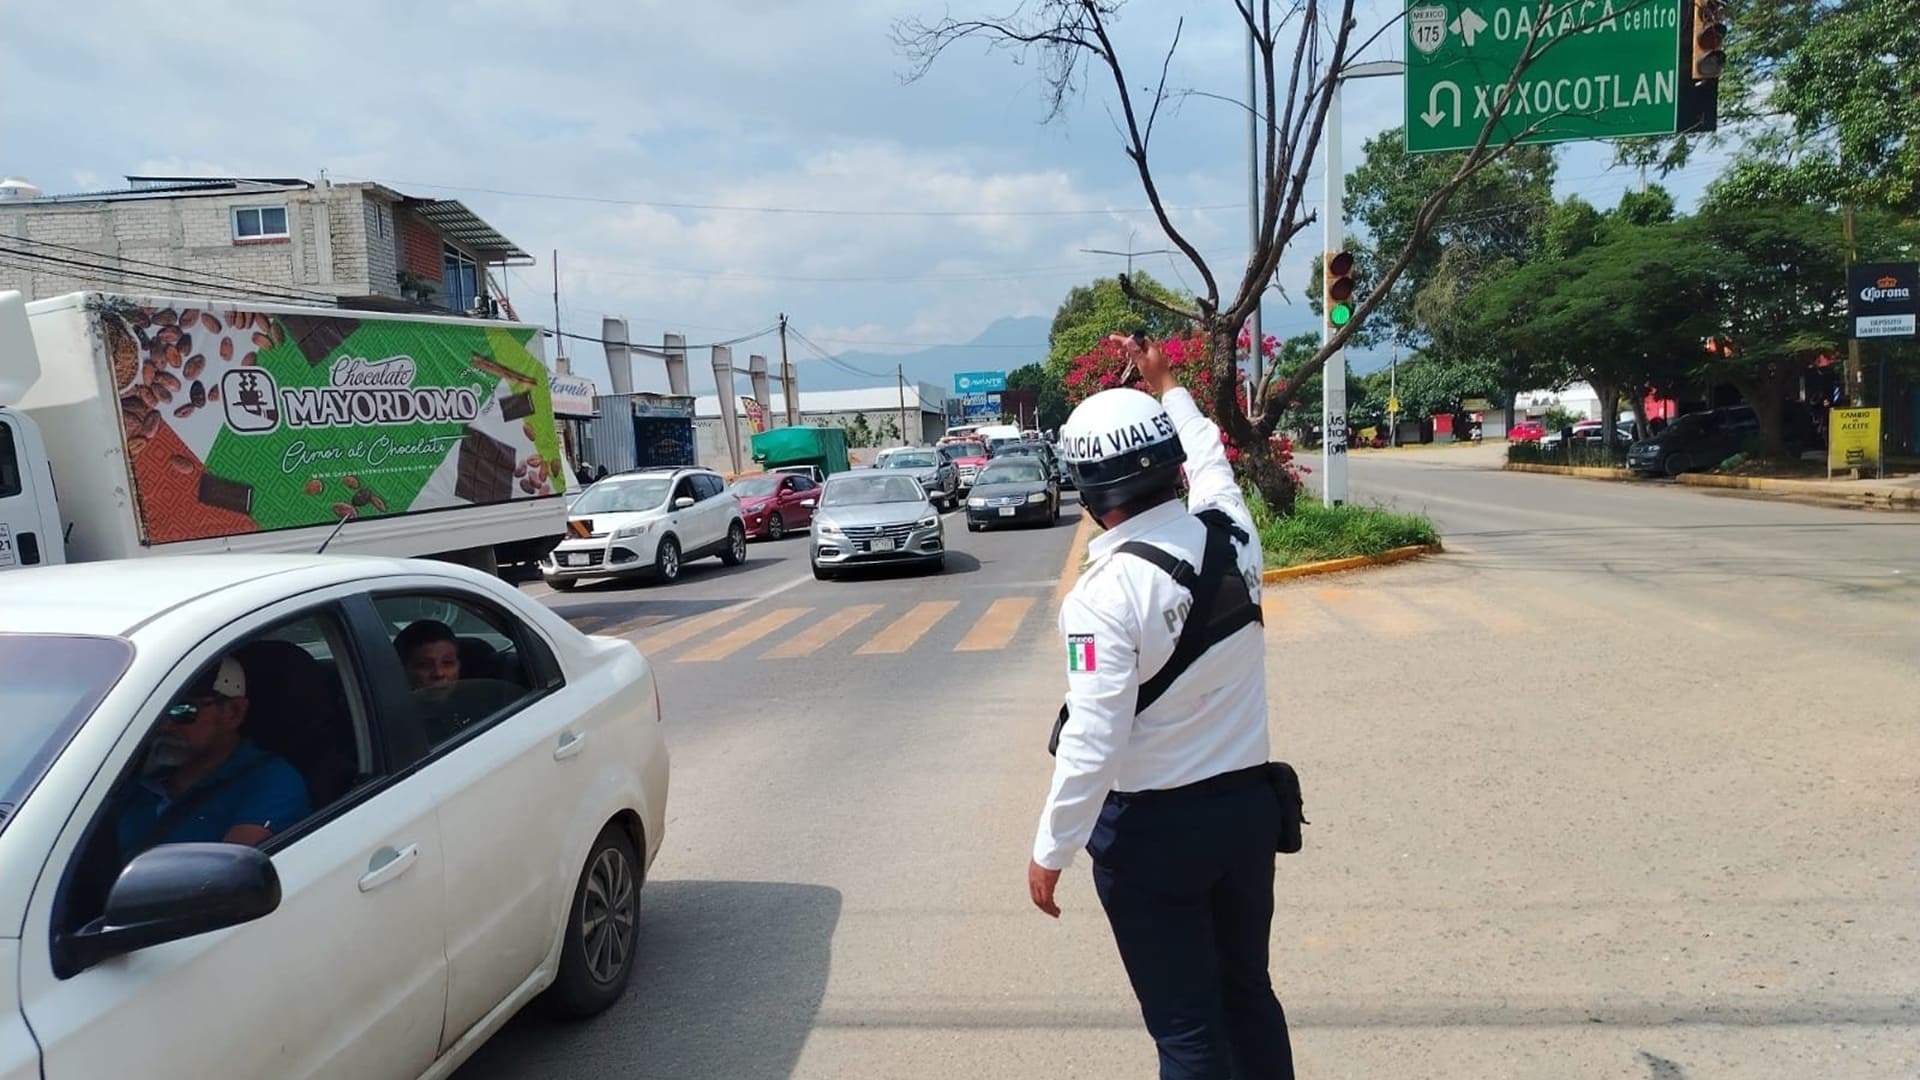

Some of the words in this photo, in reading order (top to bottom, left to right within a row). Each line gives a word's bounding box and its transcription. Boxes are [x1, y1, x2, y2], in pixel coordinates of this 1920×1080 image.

[1417, 26, 1440, 42] 175
[1494, 0, 1617, 41] OAXACA
[1624, 6, 1676, 31] centro
[1473, 70, 1674, 119] XOXOCOTLAN
[1860, 287, 1910, 303] Corona
[332, 357, 413, 387] Chocolate
[282, 388, 479, 426] MAYORDOMO
[283, 440, 343, 473] Amor
[348, 440, 366, 457] al
[367, 434, 470, 466] Chocolate
[1107, 422, 1154, 451] VIAL
[1163, 597, 1194, 634] PO
